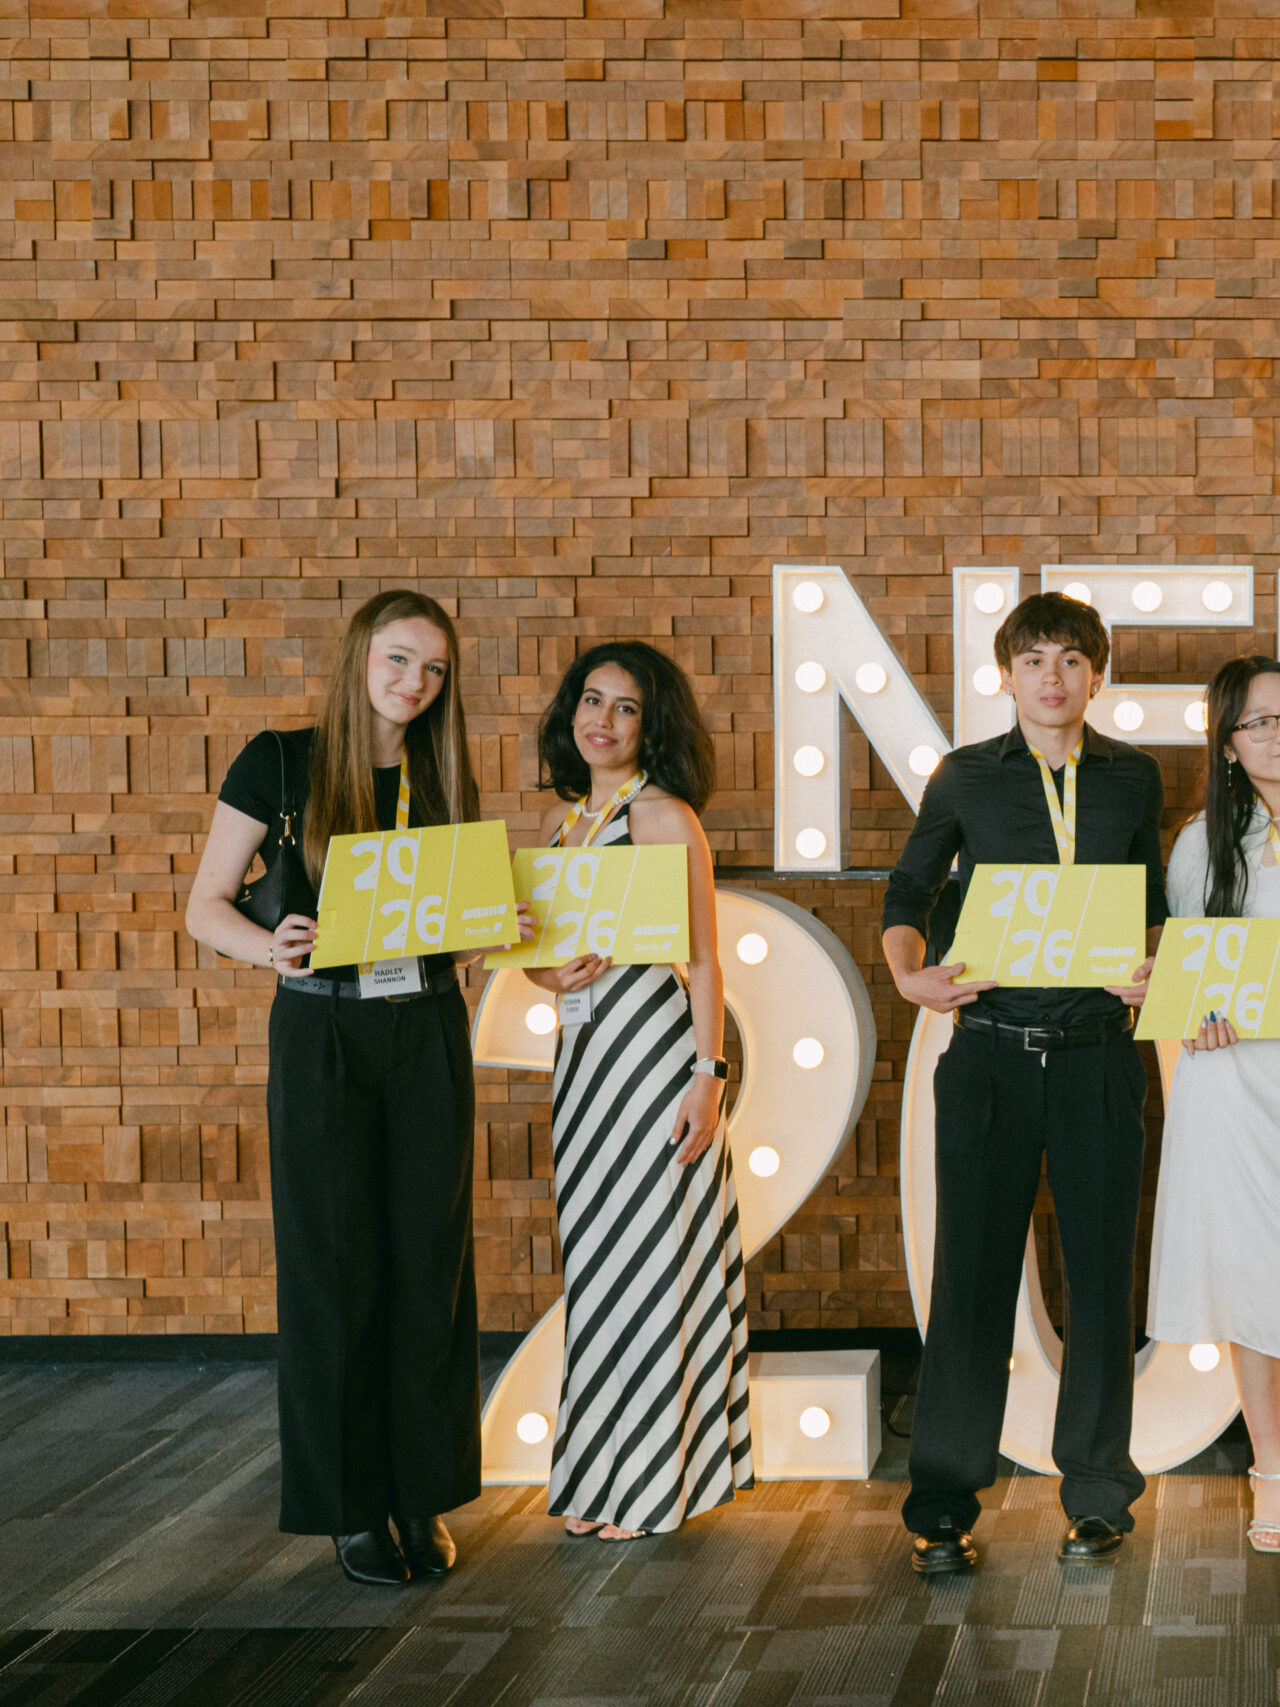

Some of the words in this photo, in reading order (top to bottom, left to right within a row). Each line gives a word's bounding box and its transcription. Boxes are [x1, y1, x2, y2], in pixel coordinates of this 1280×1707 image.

[350, 836, 418, 891] 20
[532, 853, 600, 901] 20
[990, 869, 1059, 917] 20
[379, 894, 446, 950] 26
[553, 909, 617, 958] 26
[1009, 929, 1075, 977] 26
[1181, 924, 1248, 971] 20
[373, 975, 406, 985] SHANNON
[374, 967, 403, 977] HADLEY
